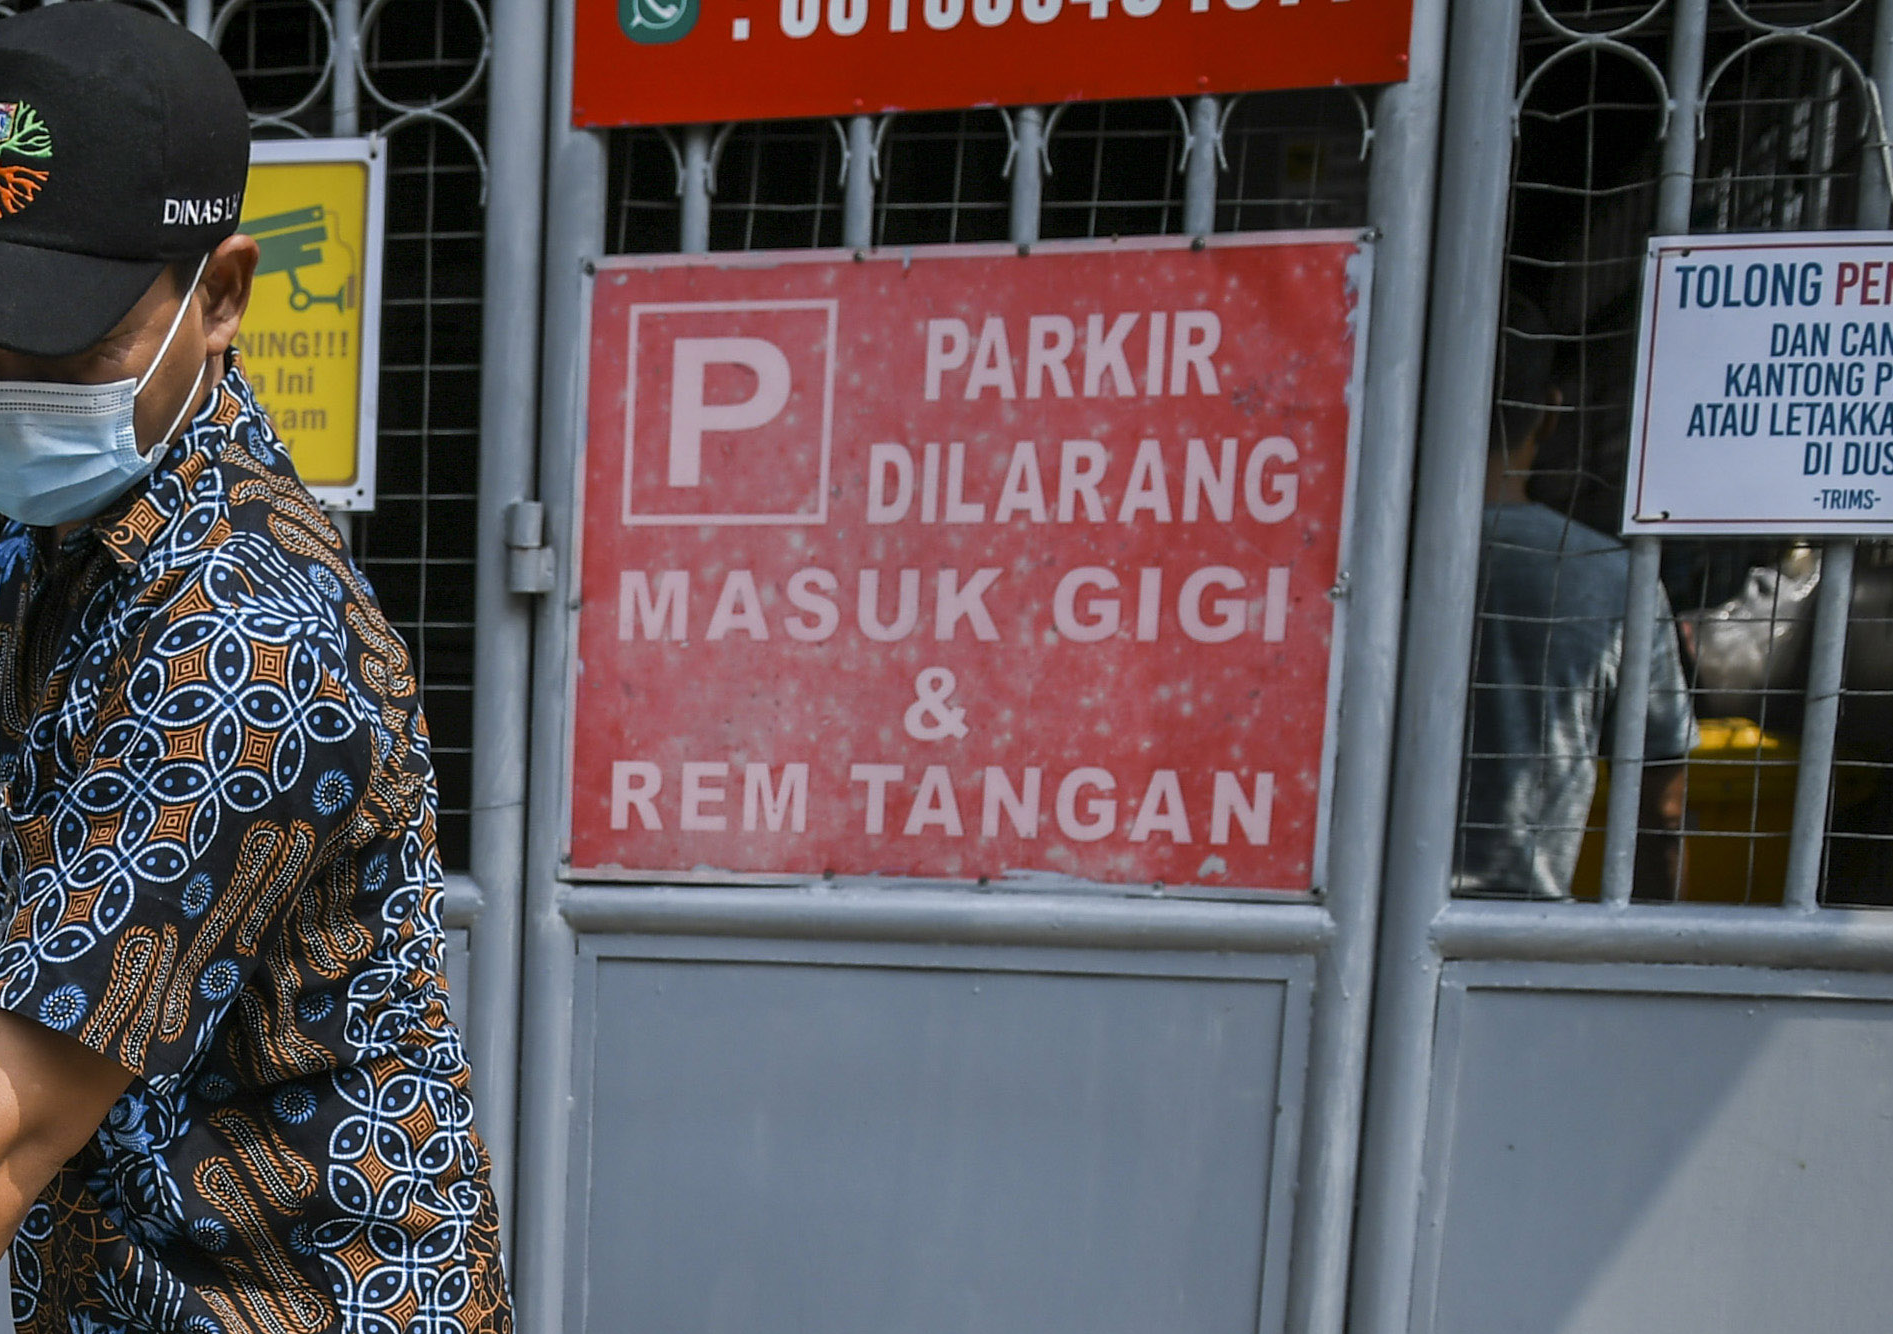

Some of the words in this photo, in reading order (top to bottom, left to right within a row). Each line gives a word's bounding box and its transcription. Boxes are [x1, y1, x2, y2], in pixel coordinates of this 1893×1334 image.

[163, 198, 223, 225] DINAS
[1675, 262, 1822, 309] TOLONG
[925, 311, 1222, 400] PARKIR
[1770, 322, 1831, 357] DAN
[1724, 362, 1865, 397] KANTONG
[668, 337, 792, 487] P
[1687, 403, 1759, 437] ATAU
[867, 437, 1300, 525] DILARANG
[1803, 442, 1833, 476] DI
[1814, 488, 1881, 510] -TRIMS-
[618, 567, 1001, 641] MASUK
[1054, 566, 1290, 644] GIGI
[905, 666, 969, 741] &
[611, 761, 810, 834] REM
[850, 764, 1275, 846] TANGAN
